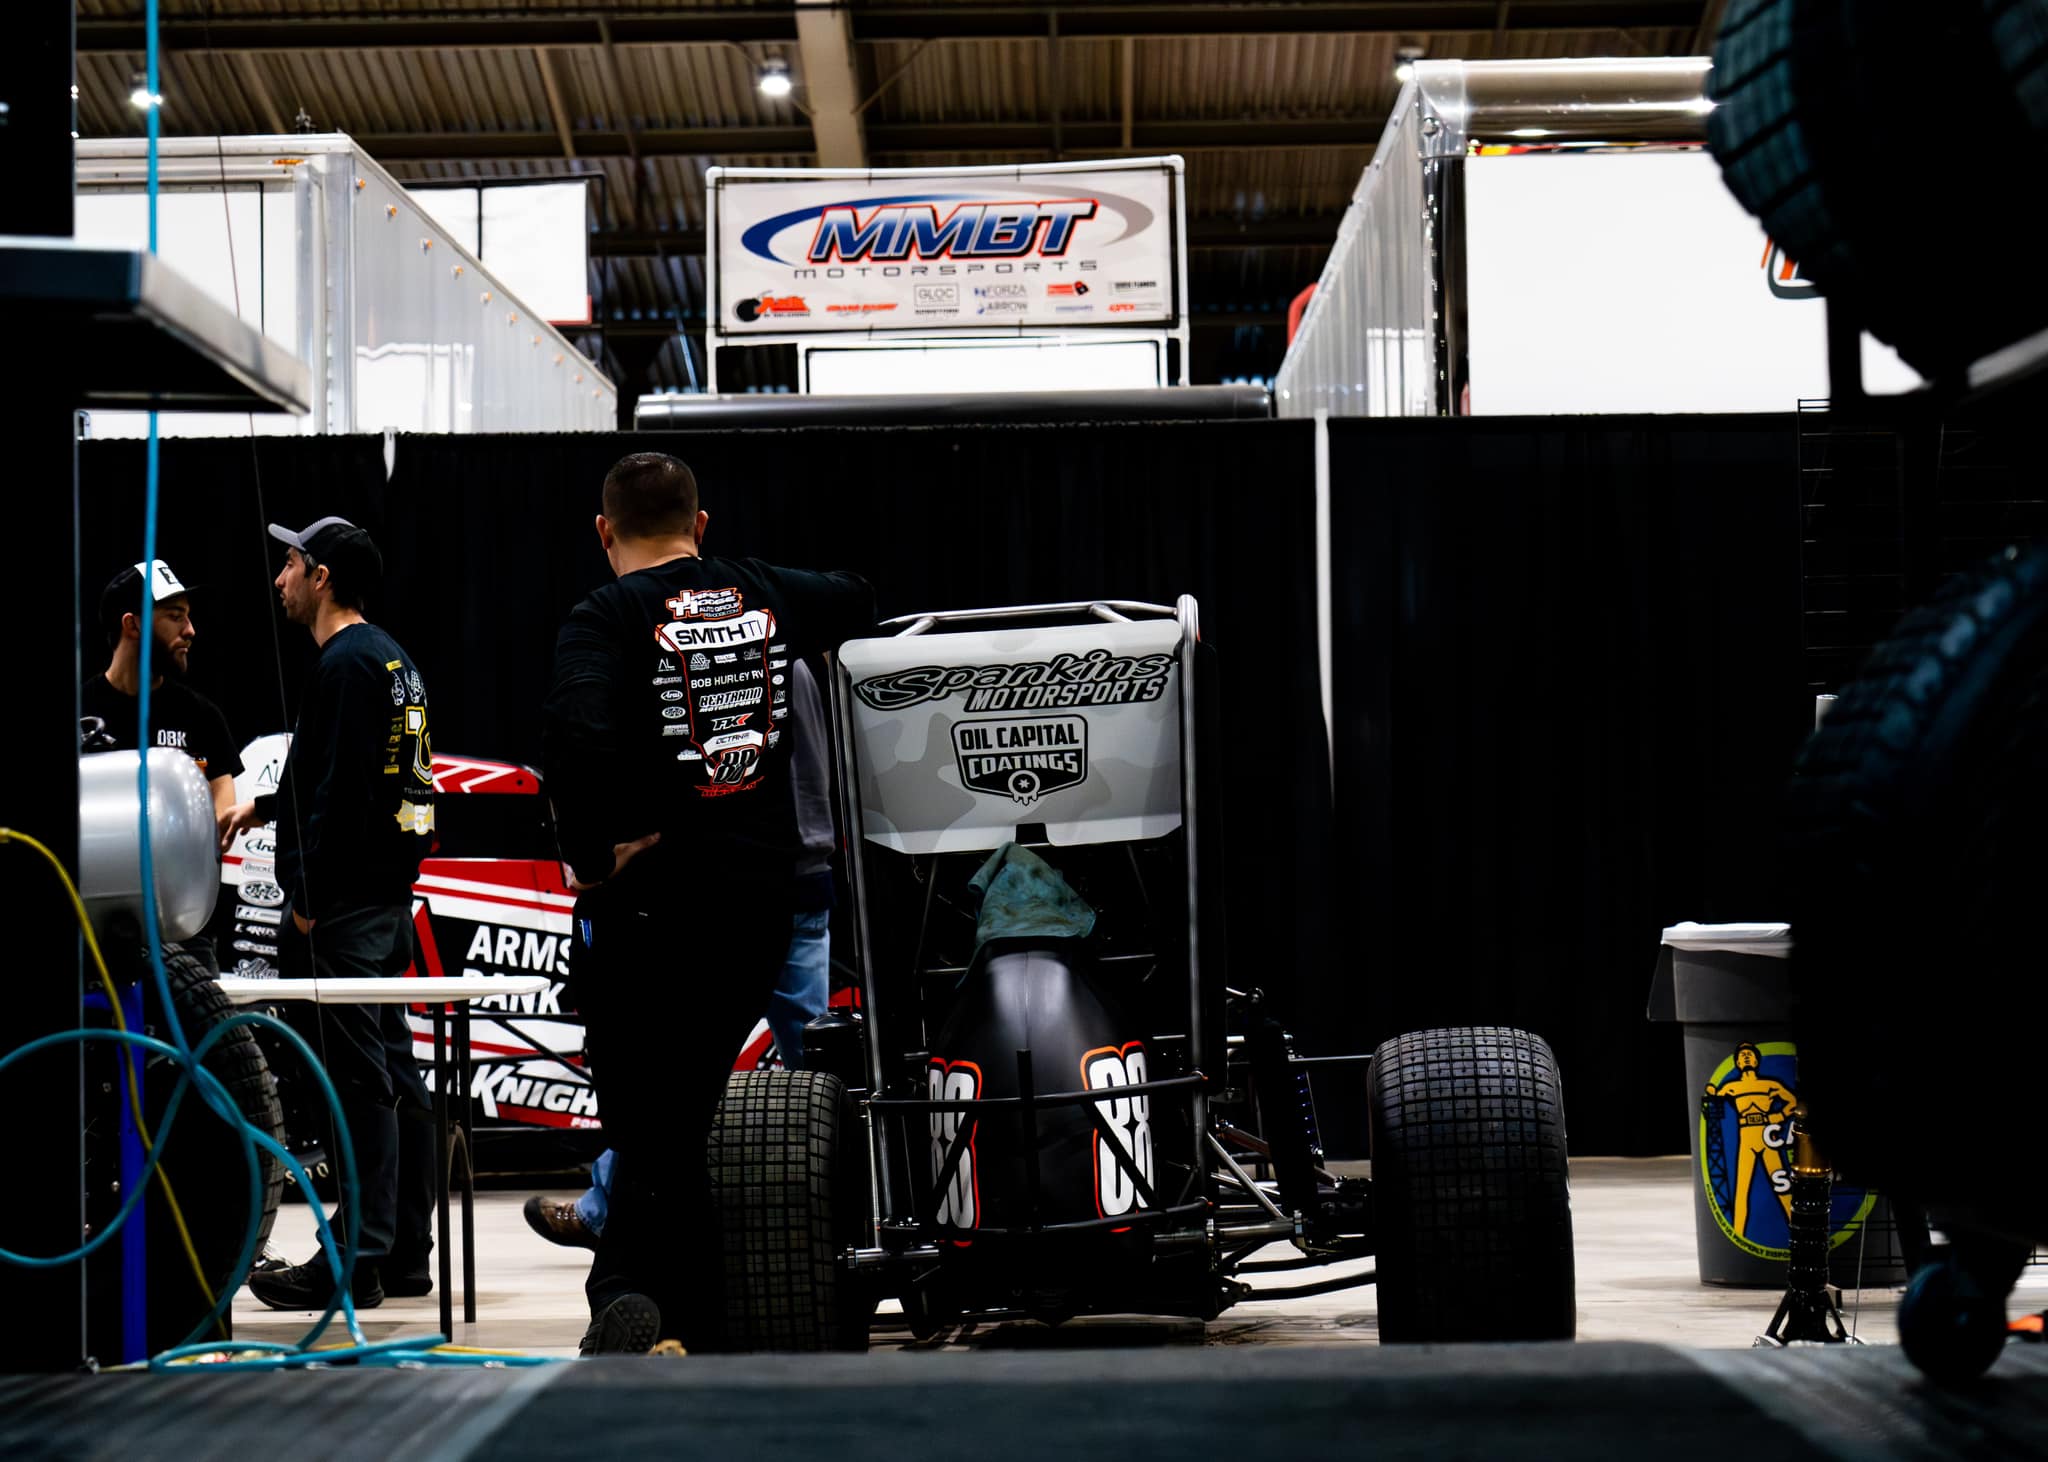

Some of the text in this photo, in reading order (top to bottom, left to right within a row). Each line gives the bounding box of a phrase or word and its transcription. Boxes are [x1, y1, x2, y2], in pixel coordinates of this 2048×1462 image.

[808, 199, 1098, 263] MMBT
[794, 260, 1098, 280] MOTORSPORTS
[690, 678, 712, 689] BOB
[714, 672, 750, 686] HURLEY
[751, 669, 764, 680] RV
[856, 649, 1172, 710] Spankins
[968, 675, 1165, 712] MOTORSPORTS
[960, 723, 1079, 750] OIL CAPITAL
[968, 752, 1078, 779] COATINGS
[1084, 1045, 1154, 1220] 88
